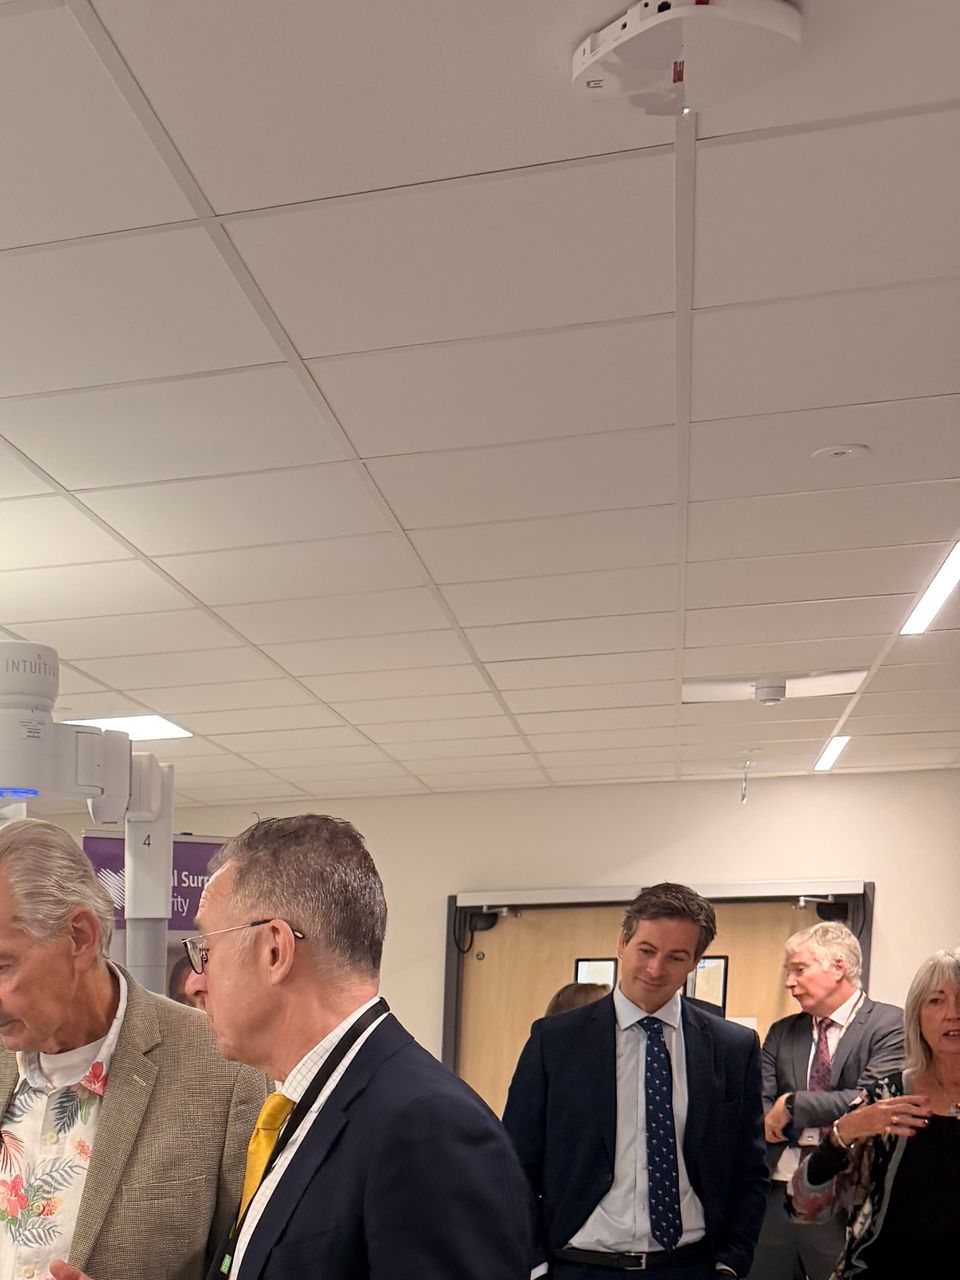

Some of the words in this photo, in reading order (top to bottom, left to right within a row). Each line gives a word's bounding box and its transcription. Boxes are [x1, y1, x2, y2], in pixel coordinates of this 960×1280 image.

[143, 834, 151, 848] 4
[181, 871, 209, 887] Surr
[171, 892, 189, 916] rity
